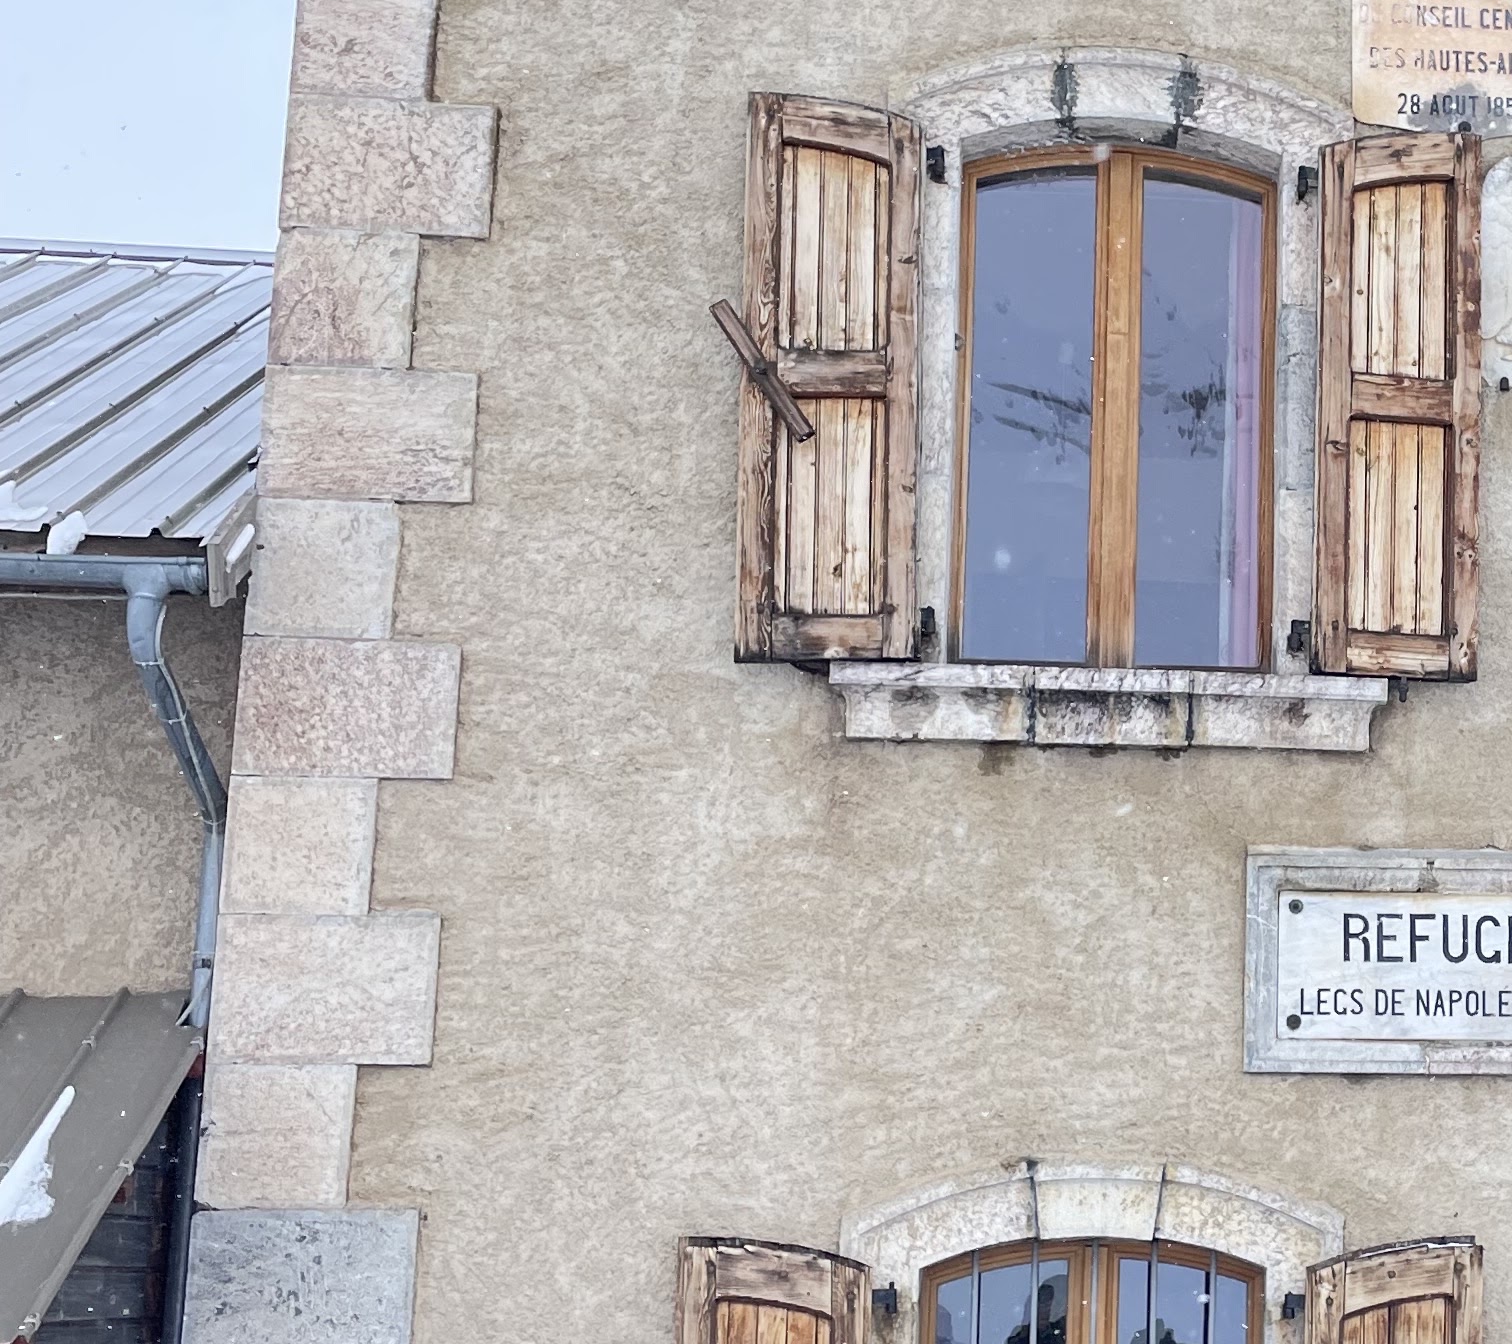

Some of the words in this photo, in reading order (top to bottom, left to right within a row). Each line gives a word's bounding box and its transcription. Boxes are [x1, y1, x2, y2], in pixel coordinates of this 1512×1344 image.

[1397, 93, 1421, 115] 28
[1300, 987, 1364, 1016] LEGS
[1375, 989, 1405, 1016] DE
